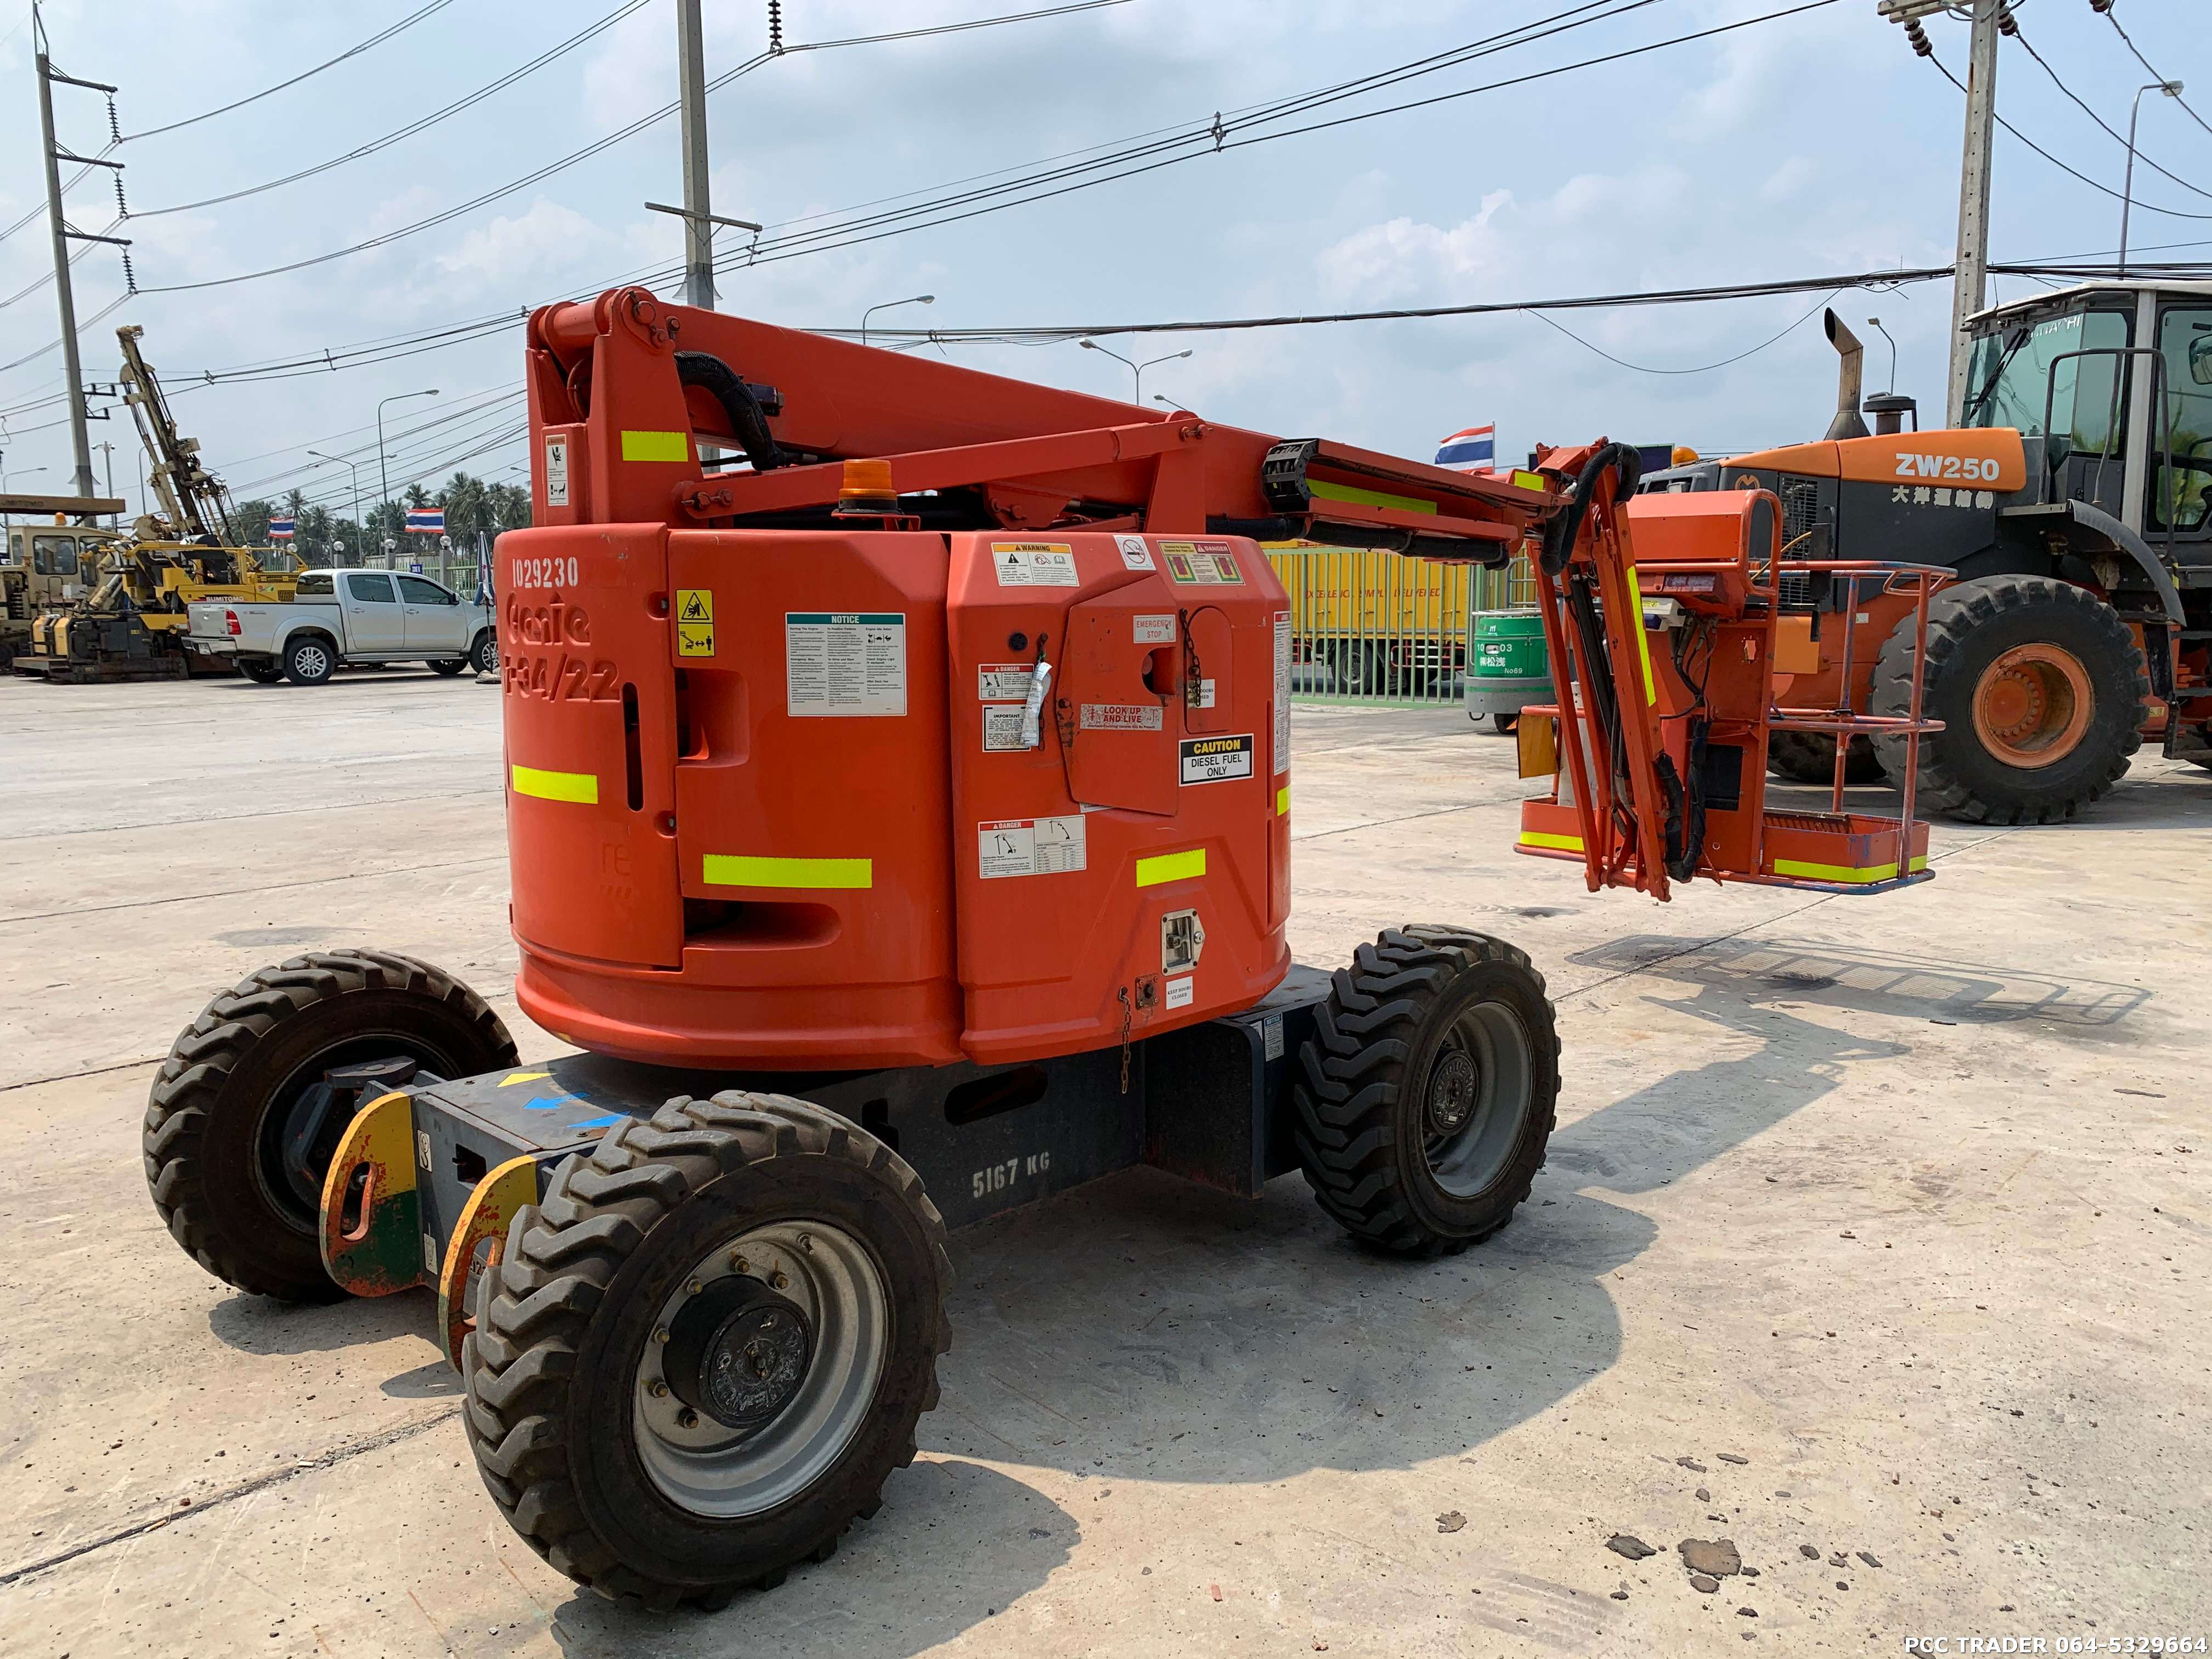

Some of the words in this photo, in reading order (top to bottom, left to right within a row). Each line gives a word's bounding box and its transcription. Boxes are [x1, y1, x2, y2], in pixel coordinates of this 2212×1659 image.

[1896, 453, 2000, 481] ZW250
[512, 556, 579, 588] 1029230
[831, 615, 860, 624] NOTICE
[1136, 619, 1172, 628] EMERGENCY
[1193, 739, 1240, 754] CAUTION
[1191, 756, 1220, 768] DIESEL
[1223, 754, 1242, 764] FUEL
[1207, 766, 1227, 777] ONLY
[1172, 992, 1187, 1000] CLOSED
[972, 1158, 1019, 1199] 5167
[1027, 1151, 1050, 1176] KG
